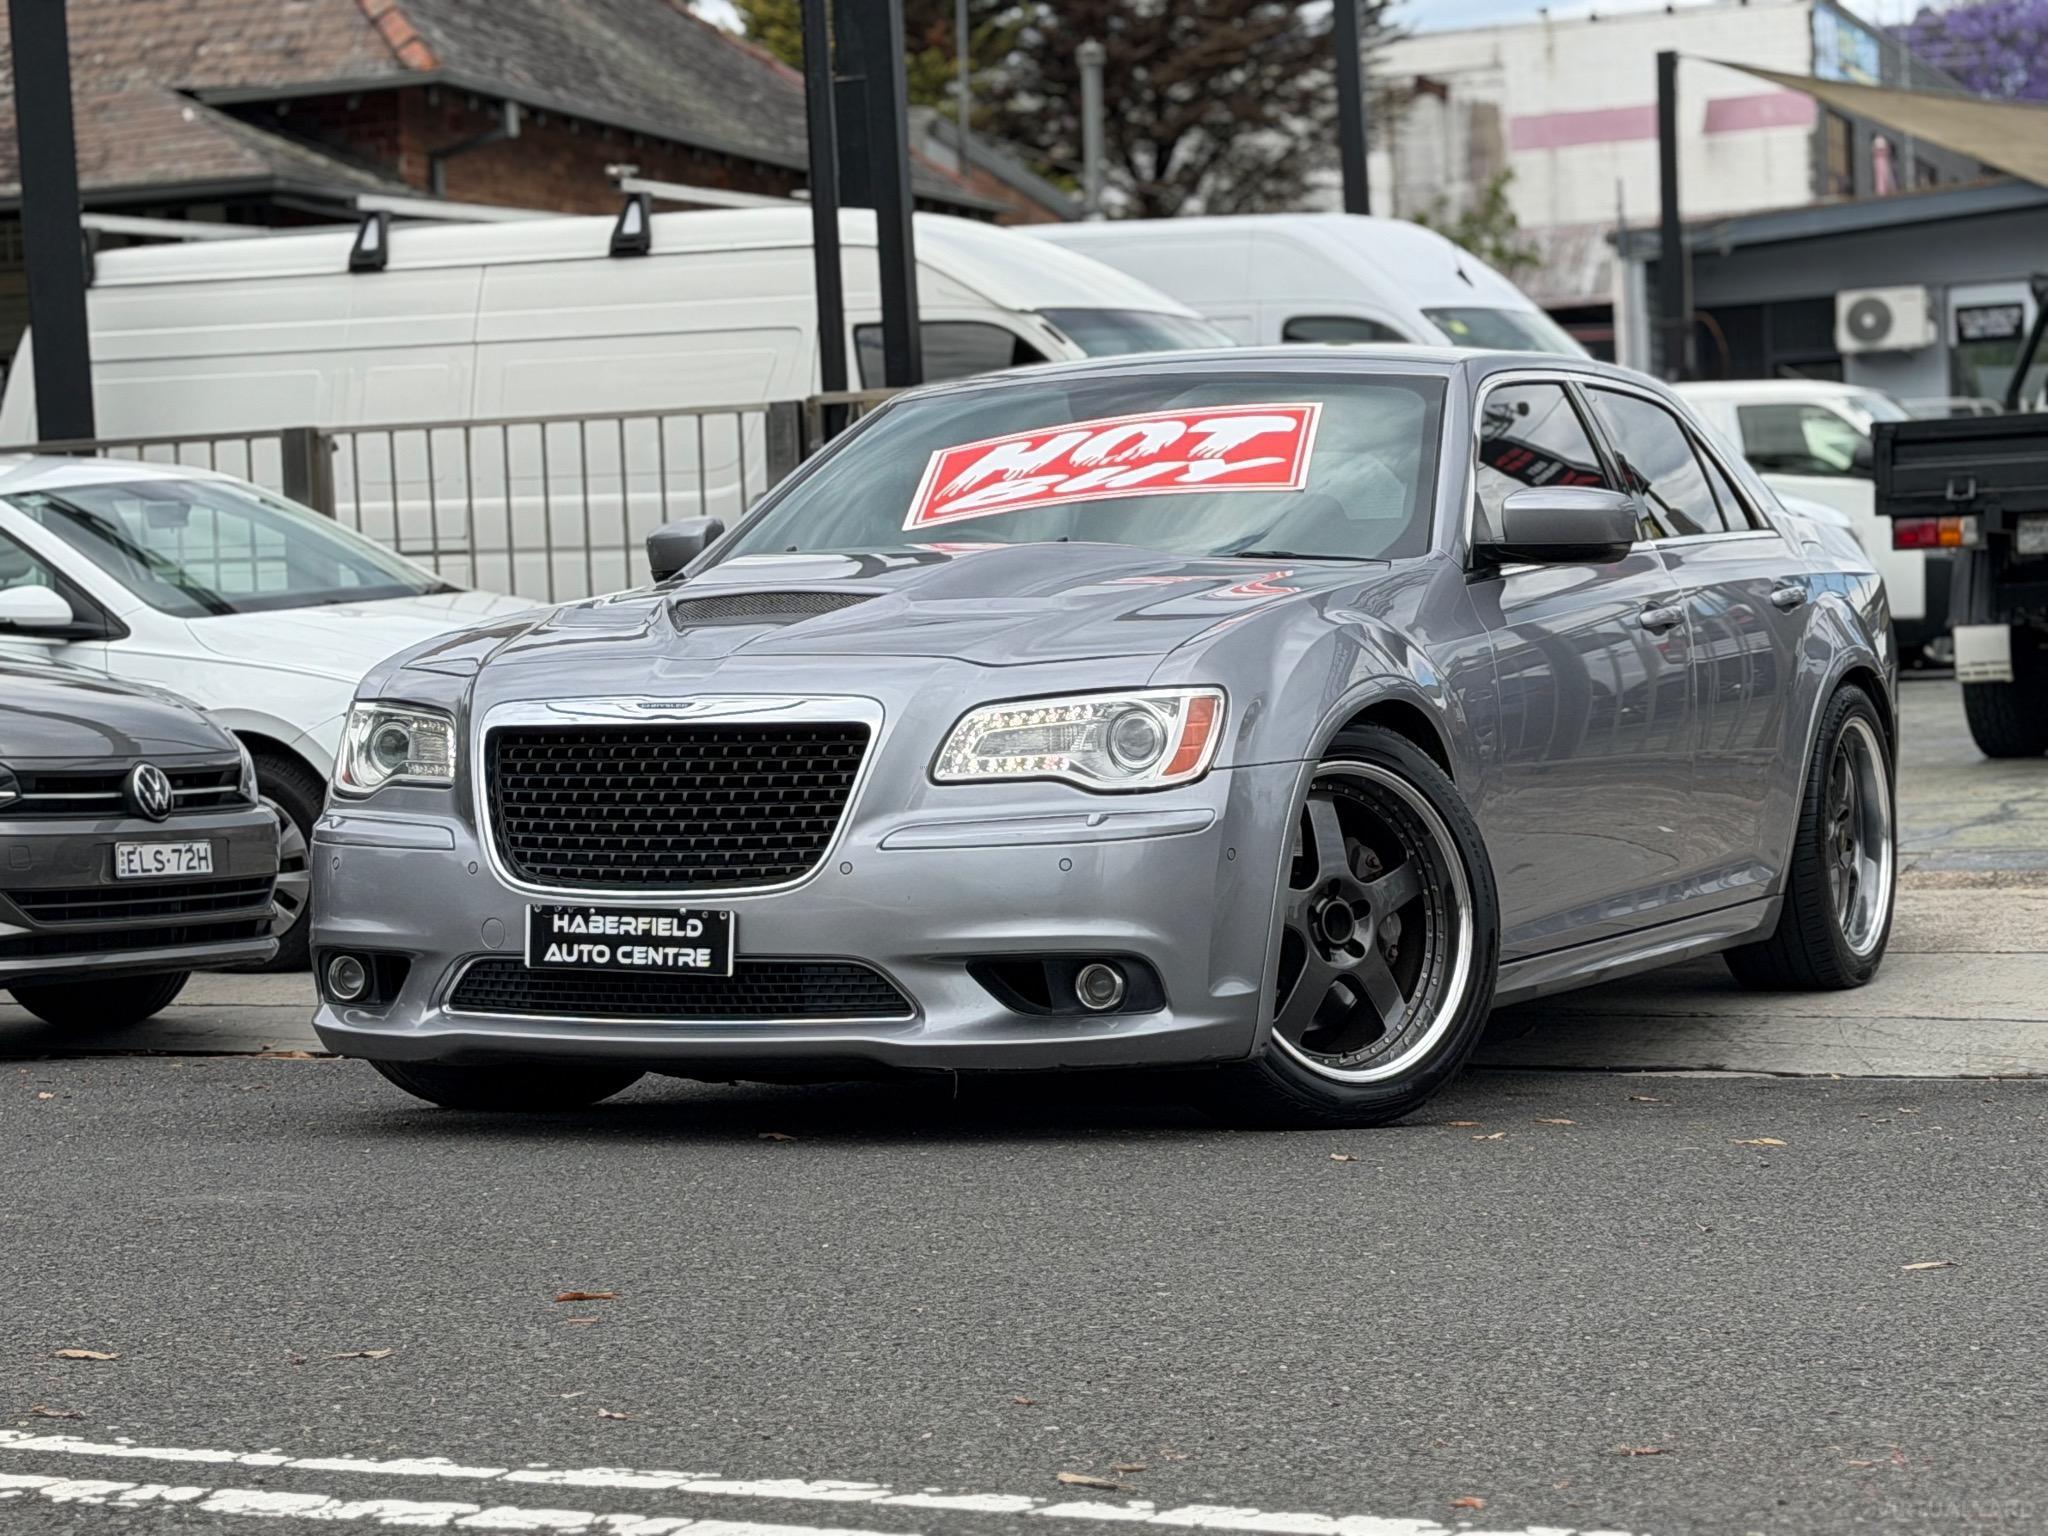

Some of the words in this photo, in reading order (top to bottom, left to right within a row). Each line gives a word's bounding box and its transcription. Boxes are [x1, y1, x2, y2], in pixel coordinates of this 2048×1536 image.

[938, 415, 1297, 498] HOT
[934, 457, 1287, 514] BUY
[552, 914, 703, 937] HABERFIELD
[543, 943, 610, 964] AUTO
[616, 946, 712, 968] CENTRE
